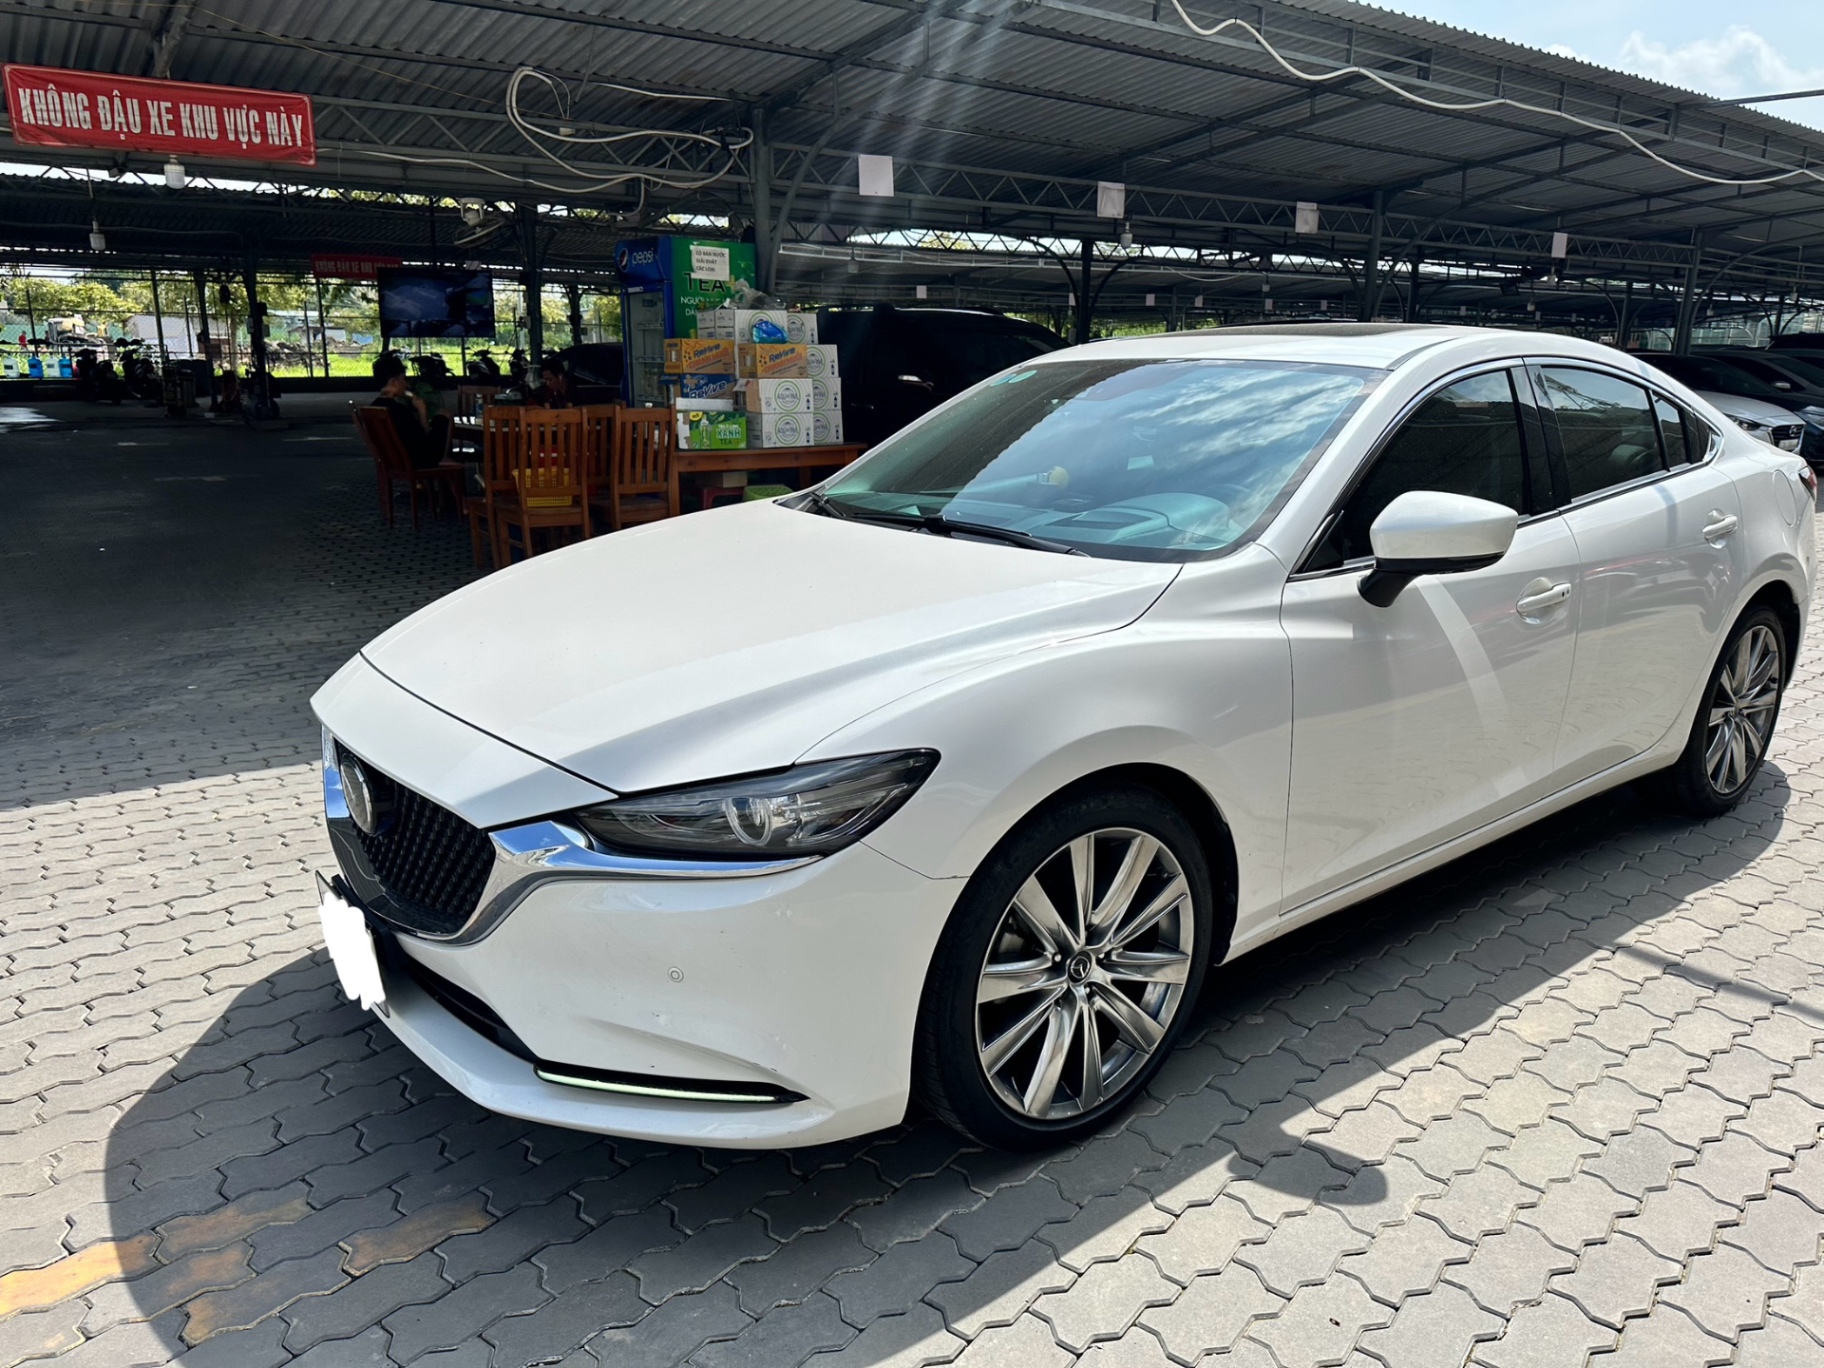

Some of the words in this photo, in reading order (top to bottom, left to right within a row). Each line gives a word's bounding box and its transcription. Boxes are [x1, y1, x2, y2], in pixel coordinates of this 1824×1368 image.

[18, 83, 92, 130] KHÔNG
[97, 89, 142, 140] ĐẬU
[146, 100, 176, 136] XE
[179, 103, 219, 140] KHU
[222, 104, 261, 149] VỰC
[265, 106, 303, 147] NÀY
[632, 247, 654, 267] pepsi
[716, 428, 742, 439] XANH
